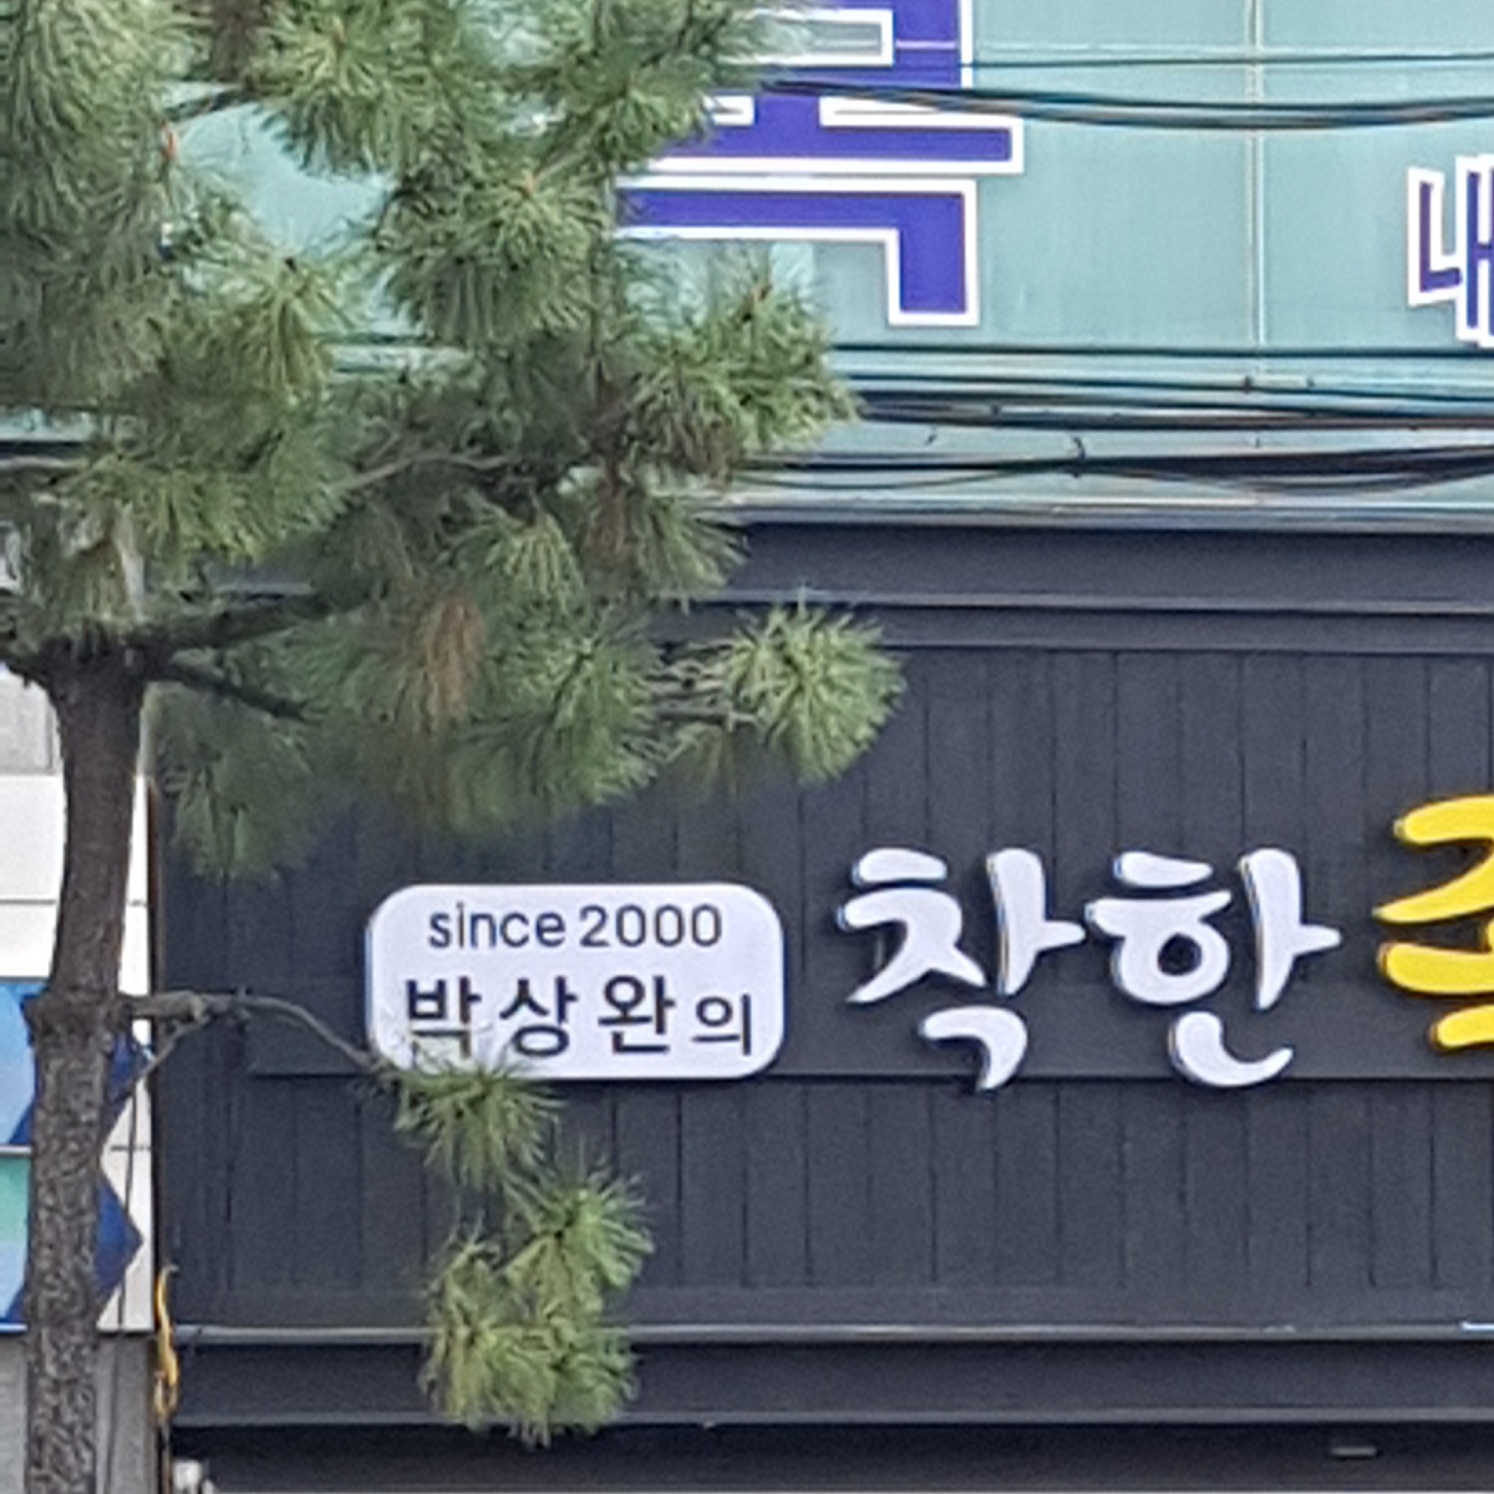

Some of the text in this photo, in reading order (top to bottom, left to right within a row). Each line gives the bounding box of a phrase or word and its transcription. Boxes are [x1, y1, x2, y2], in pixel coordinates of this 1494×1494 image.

[428, 903, 723, 950] since 2000
[838, 847, 1342, 1092] 착한
[404, 974, 753, 1058] 박상완의
